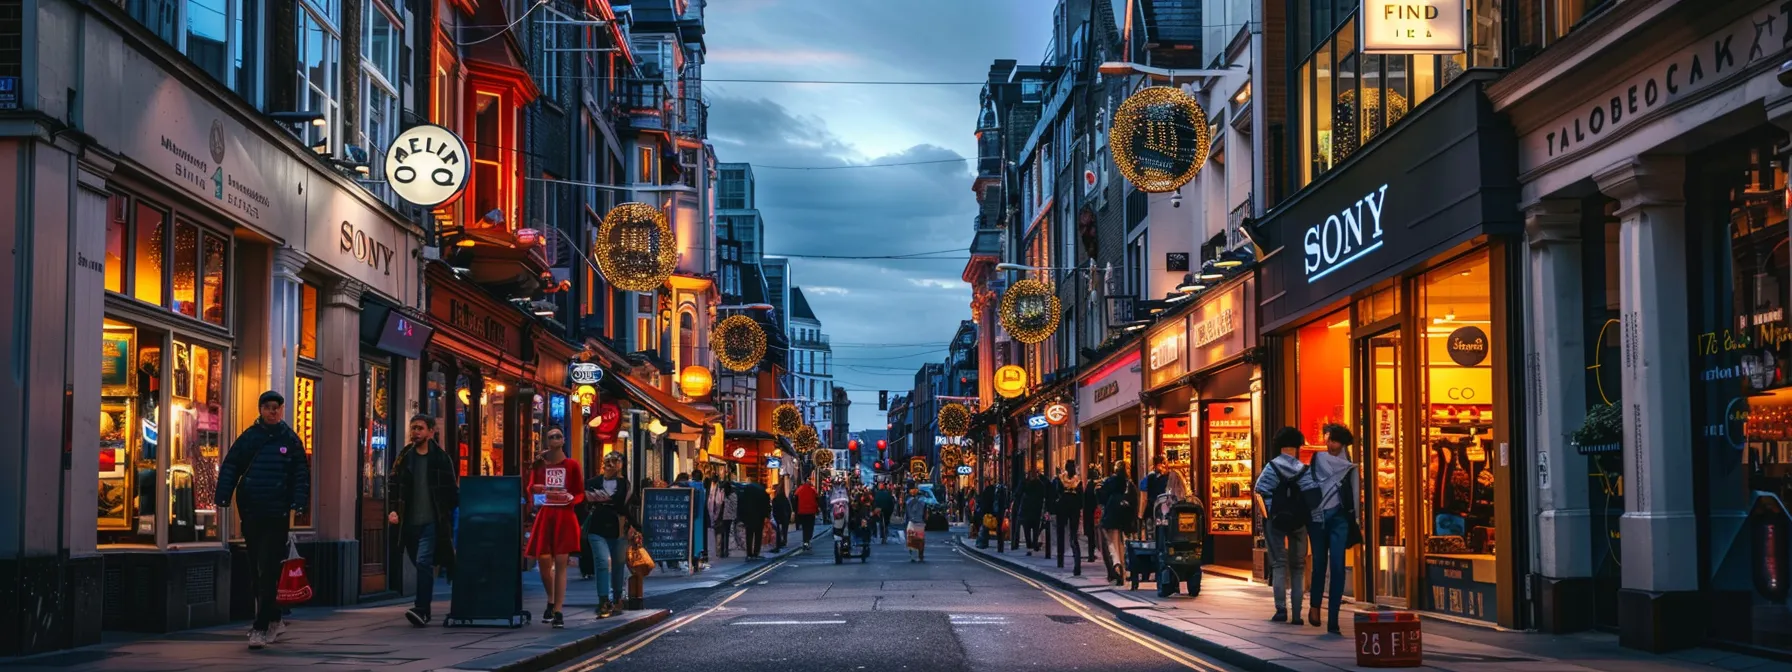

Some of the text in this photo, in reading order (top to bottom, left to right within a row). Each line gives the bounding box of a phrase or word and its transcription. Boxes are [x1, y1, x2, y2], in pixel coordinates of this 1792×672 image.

[1384, 4, 1439, 20] FIND
[1304, 183, 1388, 275] SONY
[340, 220, 394, 276] SONY
[1448, 387, 1475, 400] CO
